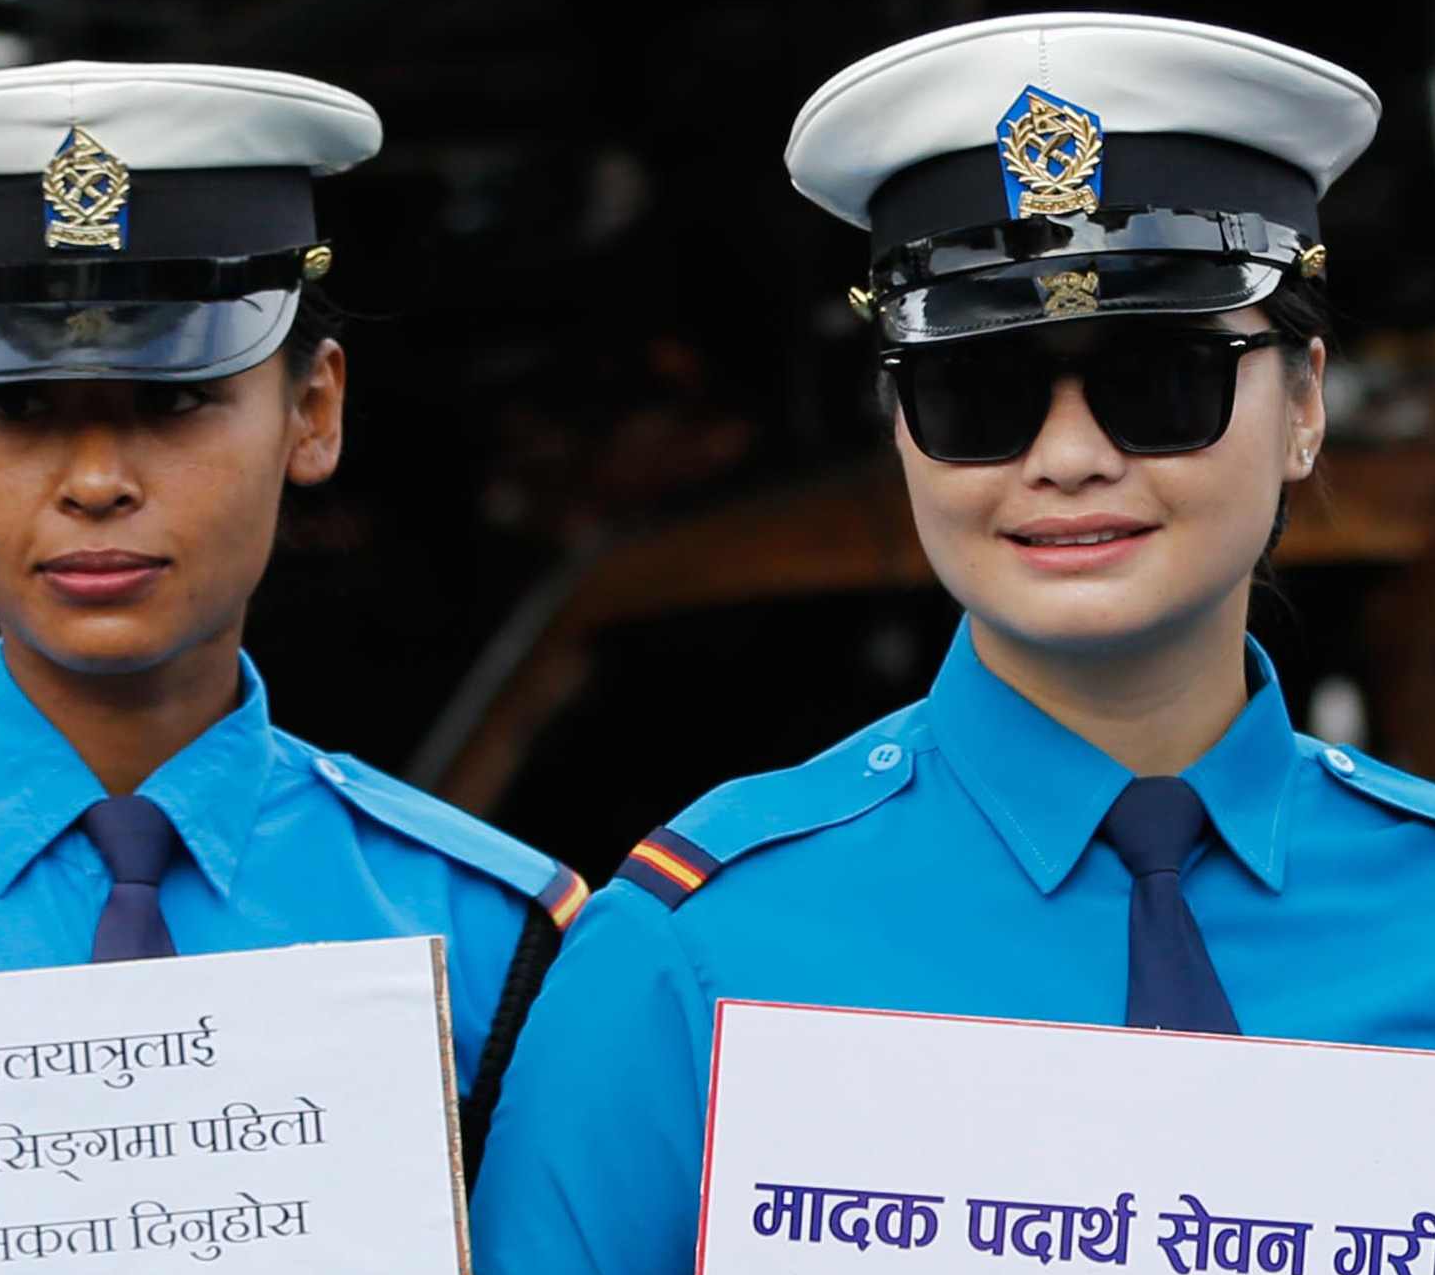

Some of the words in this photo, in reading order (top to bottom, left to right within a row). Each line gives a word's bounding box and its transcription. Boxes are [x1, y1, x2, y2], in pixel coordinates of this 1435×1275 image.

[189, 1097, 328, 1154] पहिलो
[128, 1192, 312, 1262] दिनुहोस
[752, 1182, 945, 1251] मादक
[966, 1192, 1138, 1266] पदार्थ
